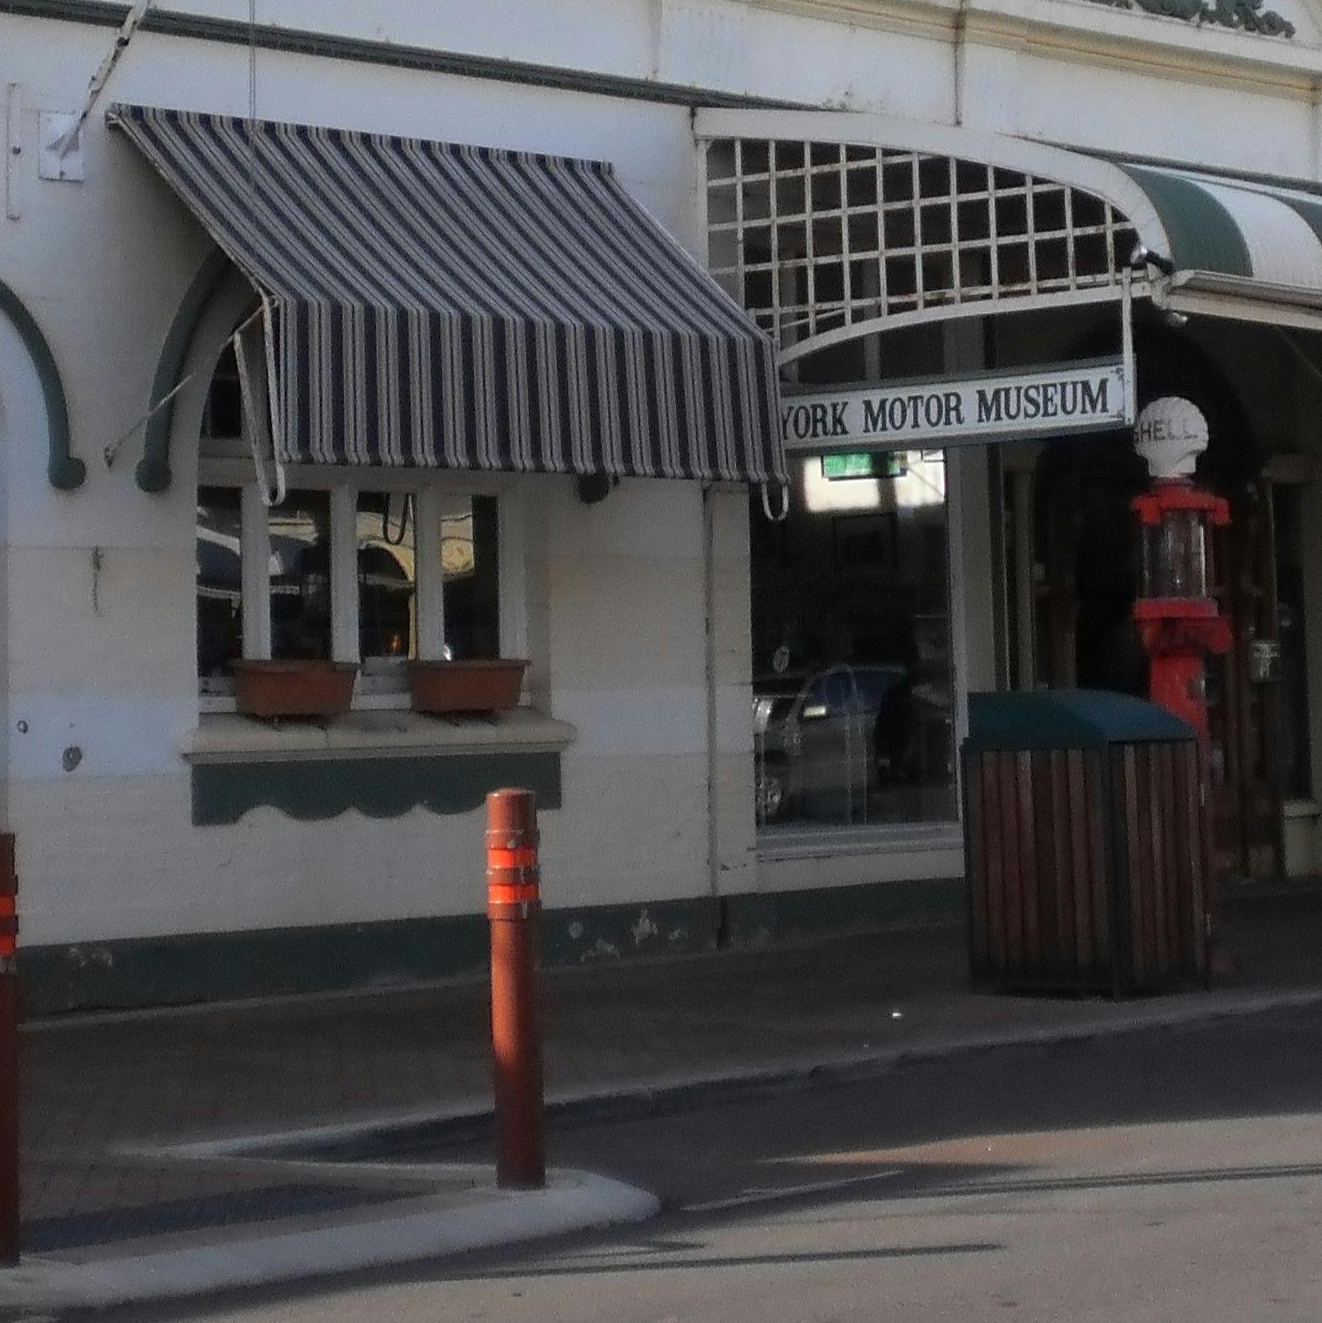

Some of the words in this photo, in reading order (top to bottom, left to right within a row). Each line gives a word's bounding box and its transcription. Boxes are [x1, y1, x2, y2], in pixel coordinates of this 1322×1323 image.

[780, 401, 849, 440] YORK
[863, 391, 963, 433] MOTOR
[977, 378, 1109, 423] MUSEUM
